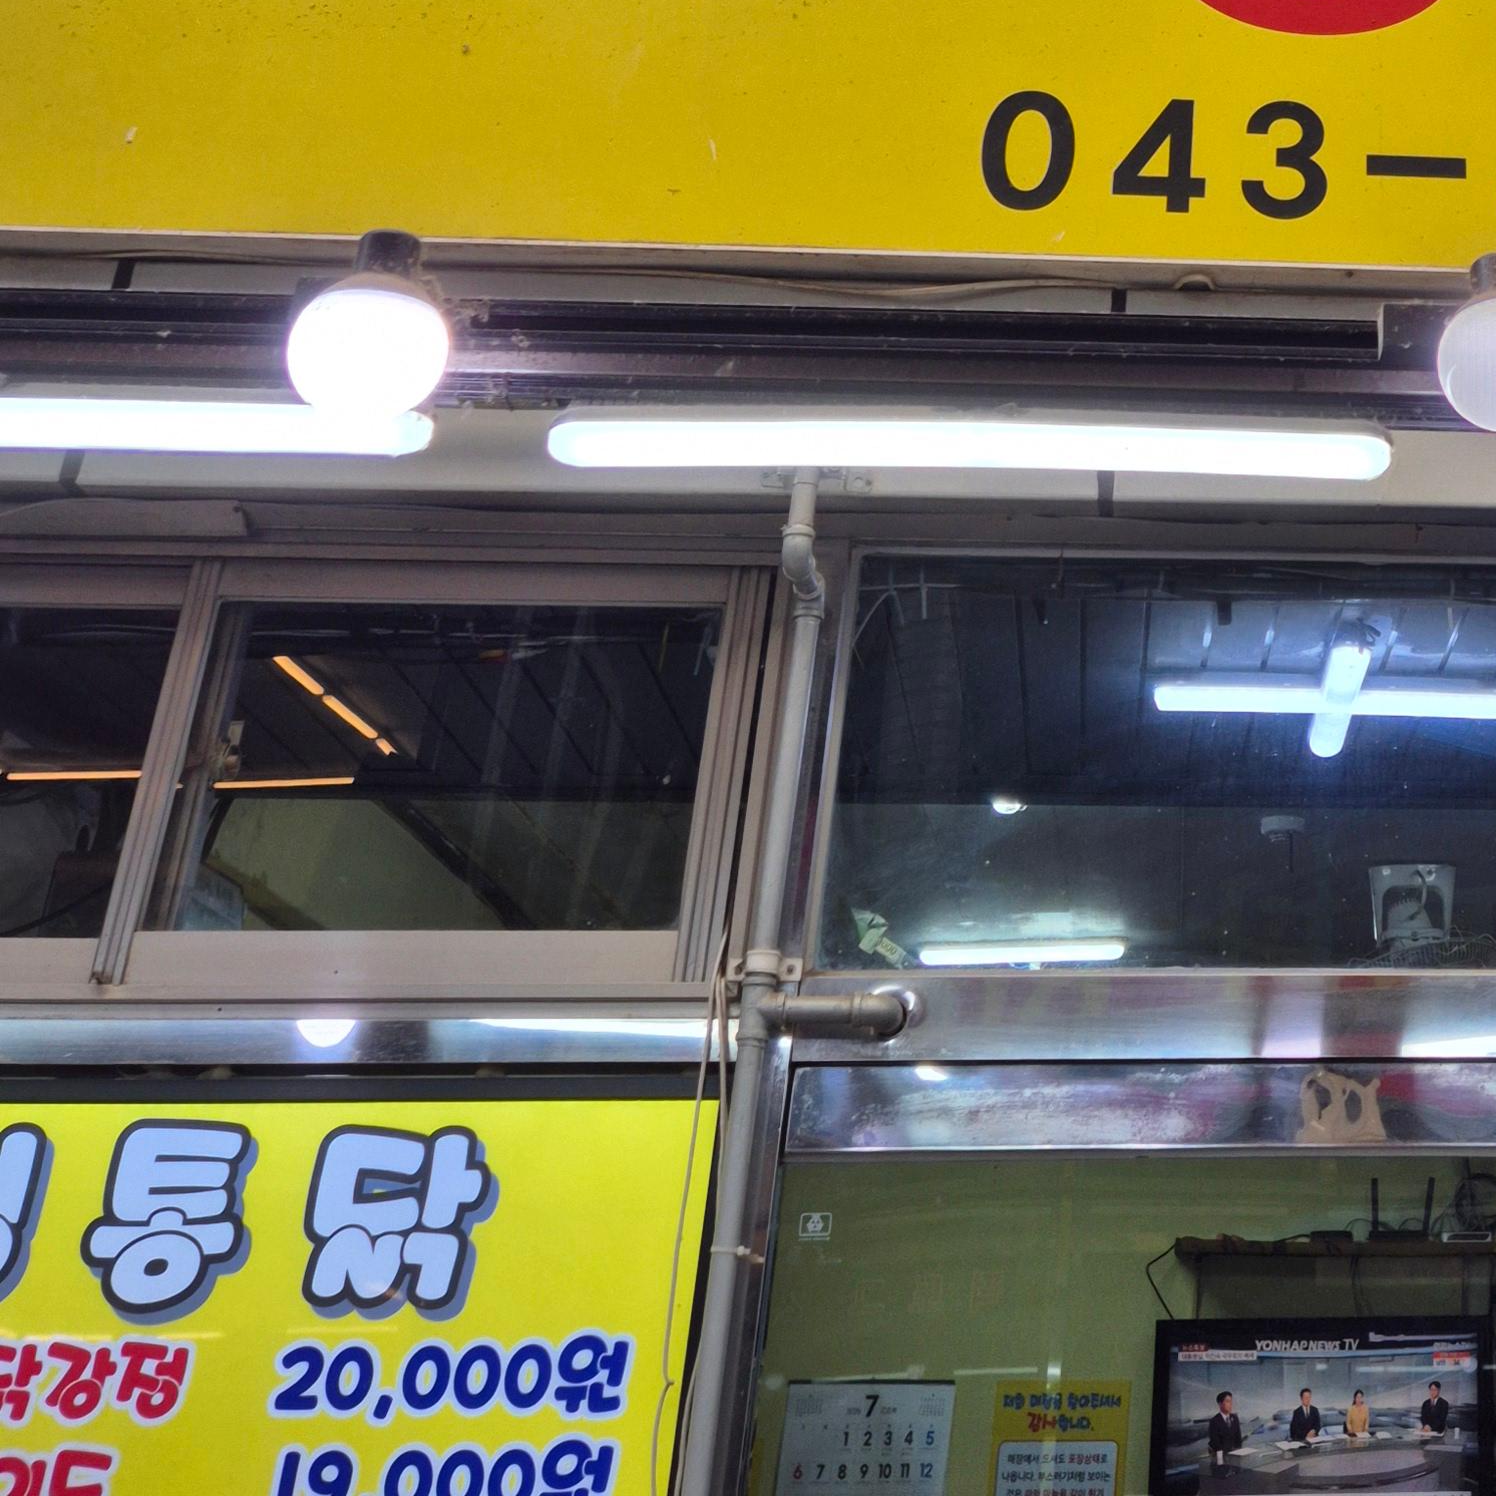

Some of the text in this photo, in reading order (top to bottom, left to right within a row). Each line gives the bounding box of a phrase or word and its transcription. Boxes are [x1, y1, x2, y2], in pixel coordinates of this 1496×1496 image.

[0, 1118, 496, 1320] 통닭
[1343, 1338, 1360, 1351] TV
[274, 1334, 630, 1420] 20,000원
[865, 1394, 879, 1418] 7
[843, 1430, 935, 1446] 1 2 3 4 5
[793, 1463, 934, 1479] 6 7 8 9 10 11 12
